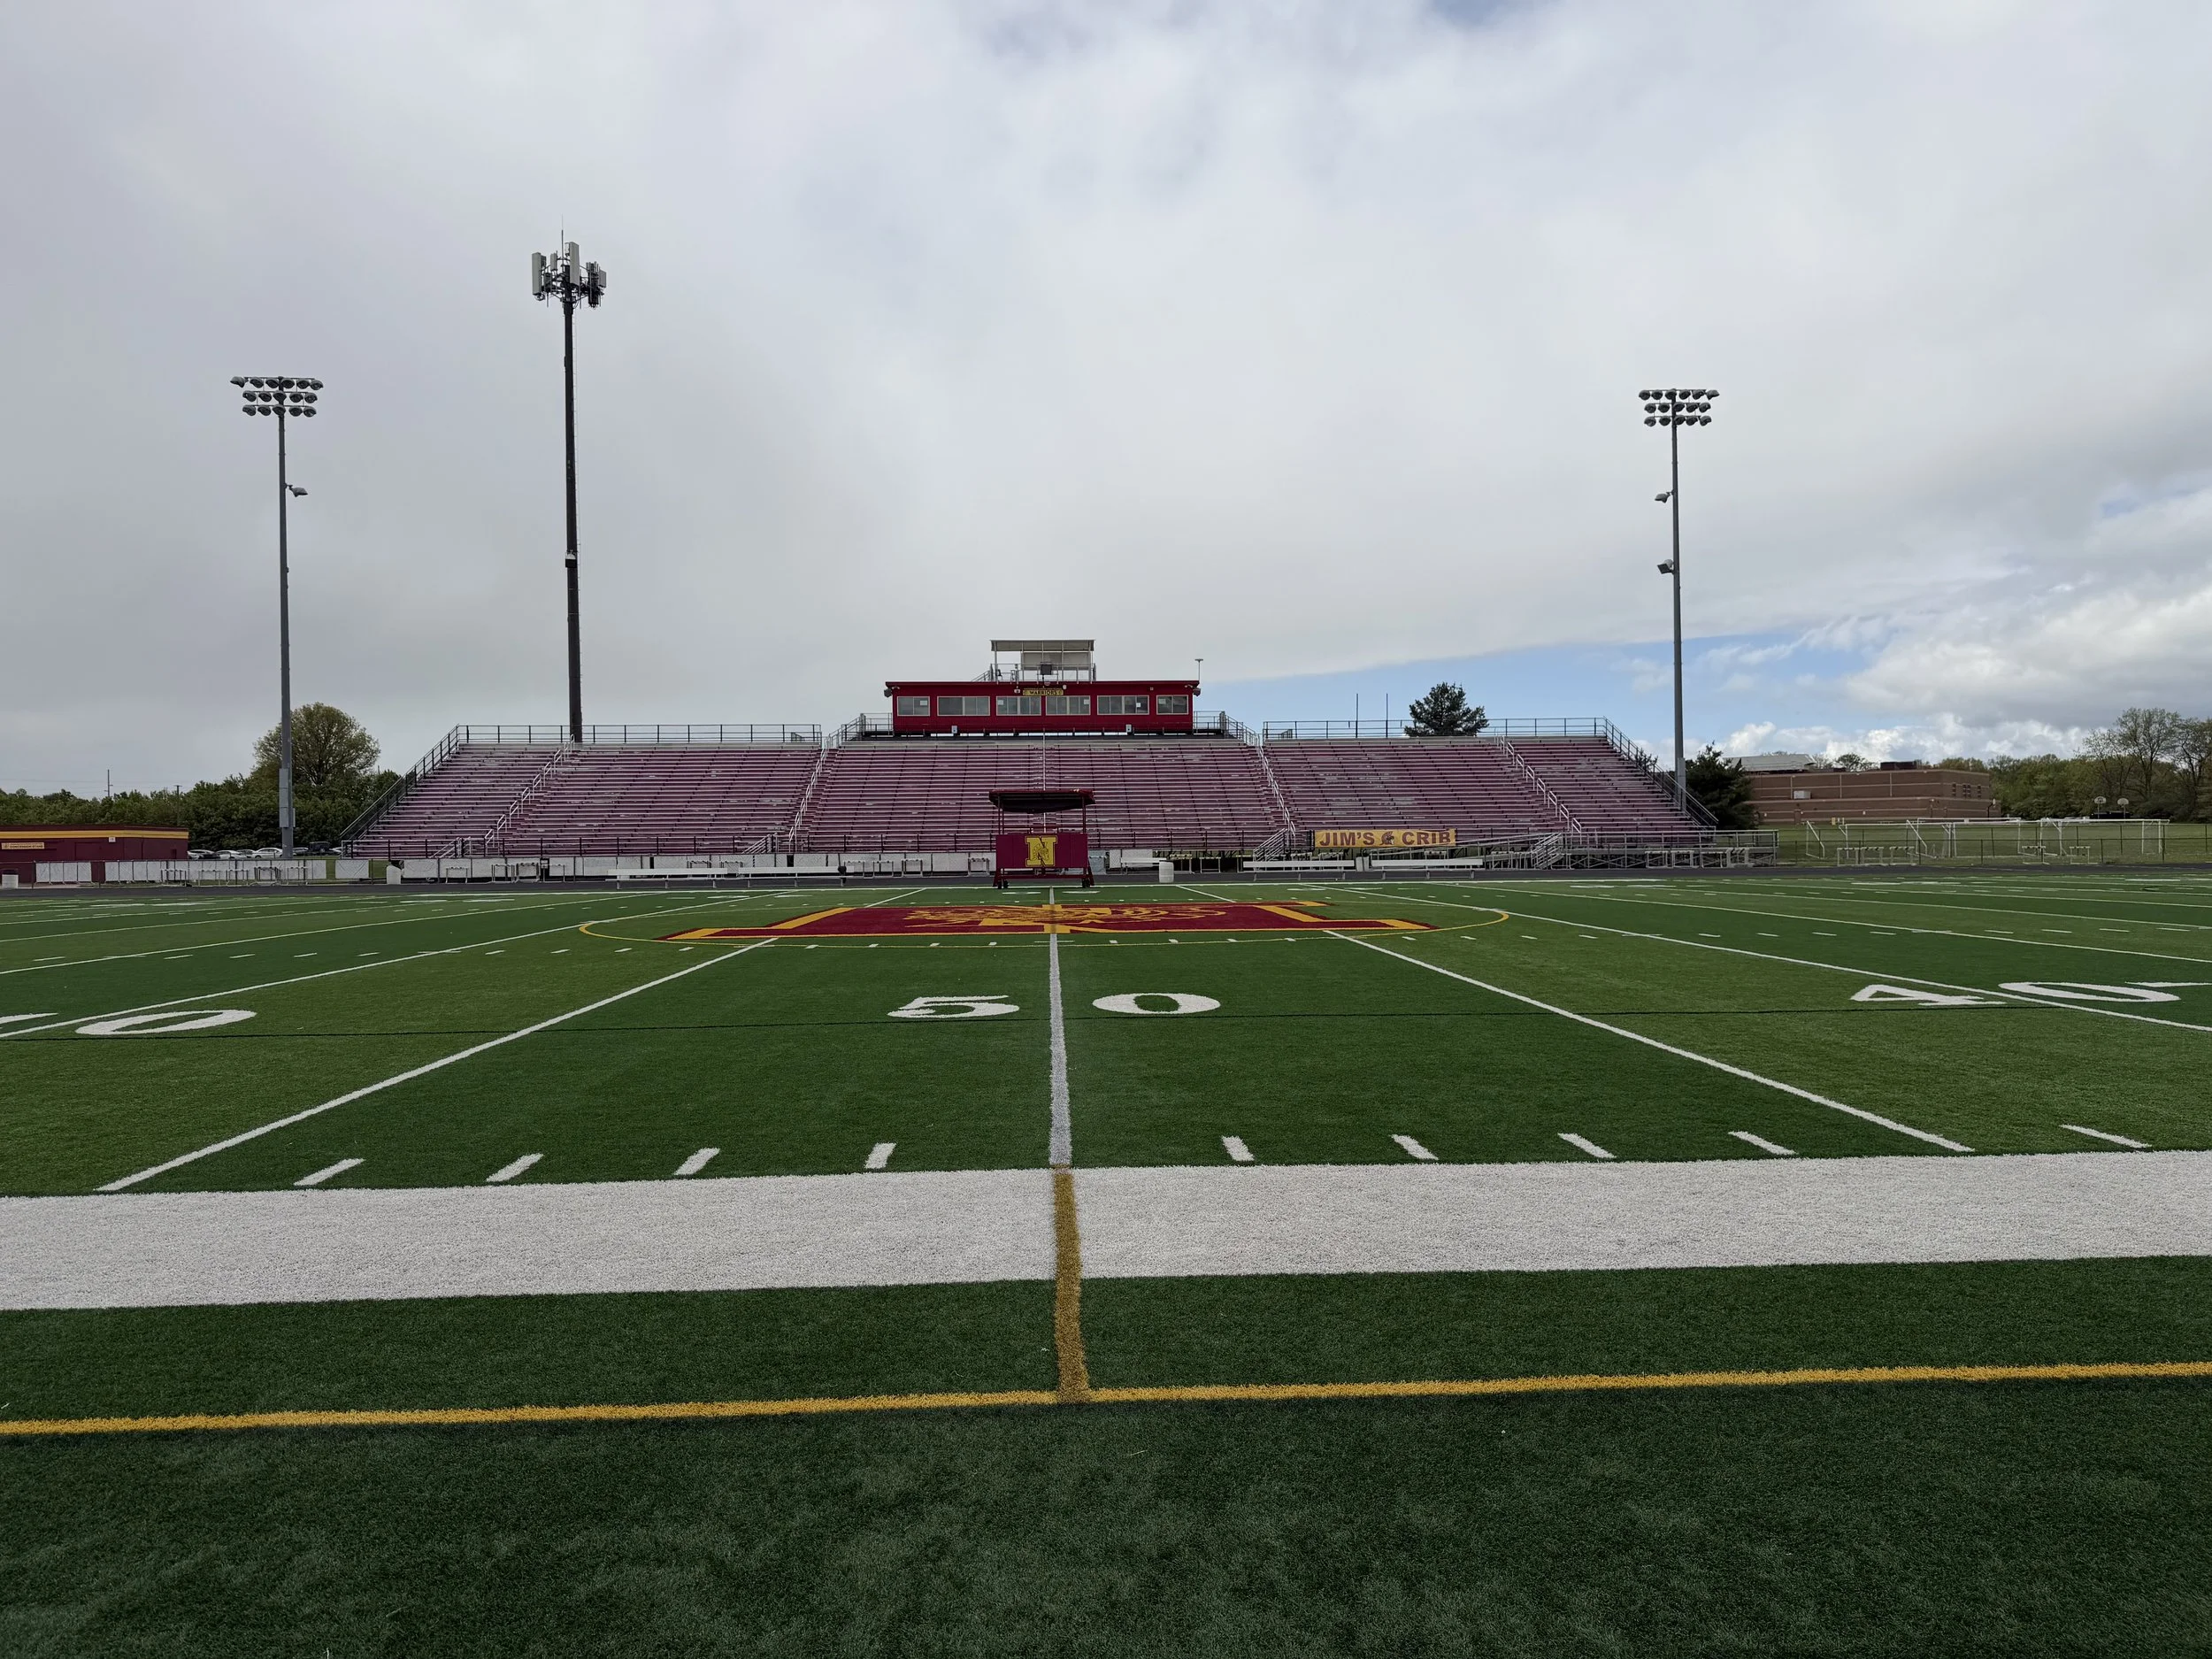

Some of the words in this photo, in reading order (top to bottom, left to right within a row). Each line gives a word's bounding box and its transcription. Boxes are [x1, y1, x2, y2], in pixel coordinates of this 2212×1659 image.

[1319, 832, 1375, 846] JIM'S
[1402, 831, 1451, 846] CRIB
[1025, 835, 1058, 867] N
